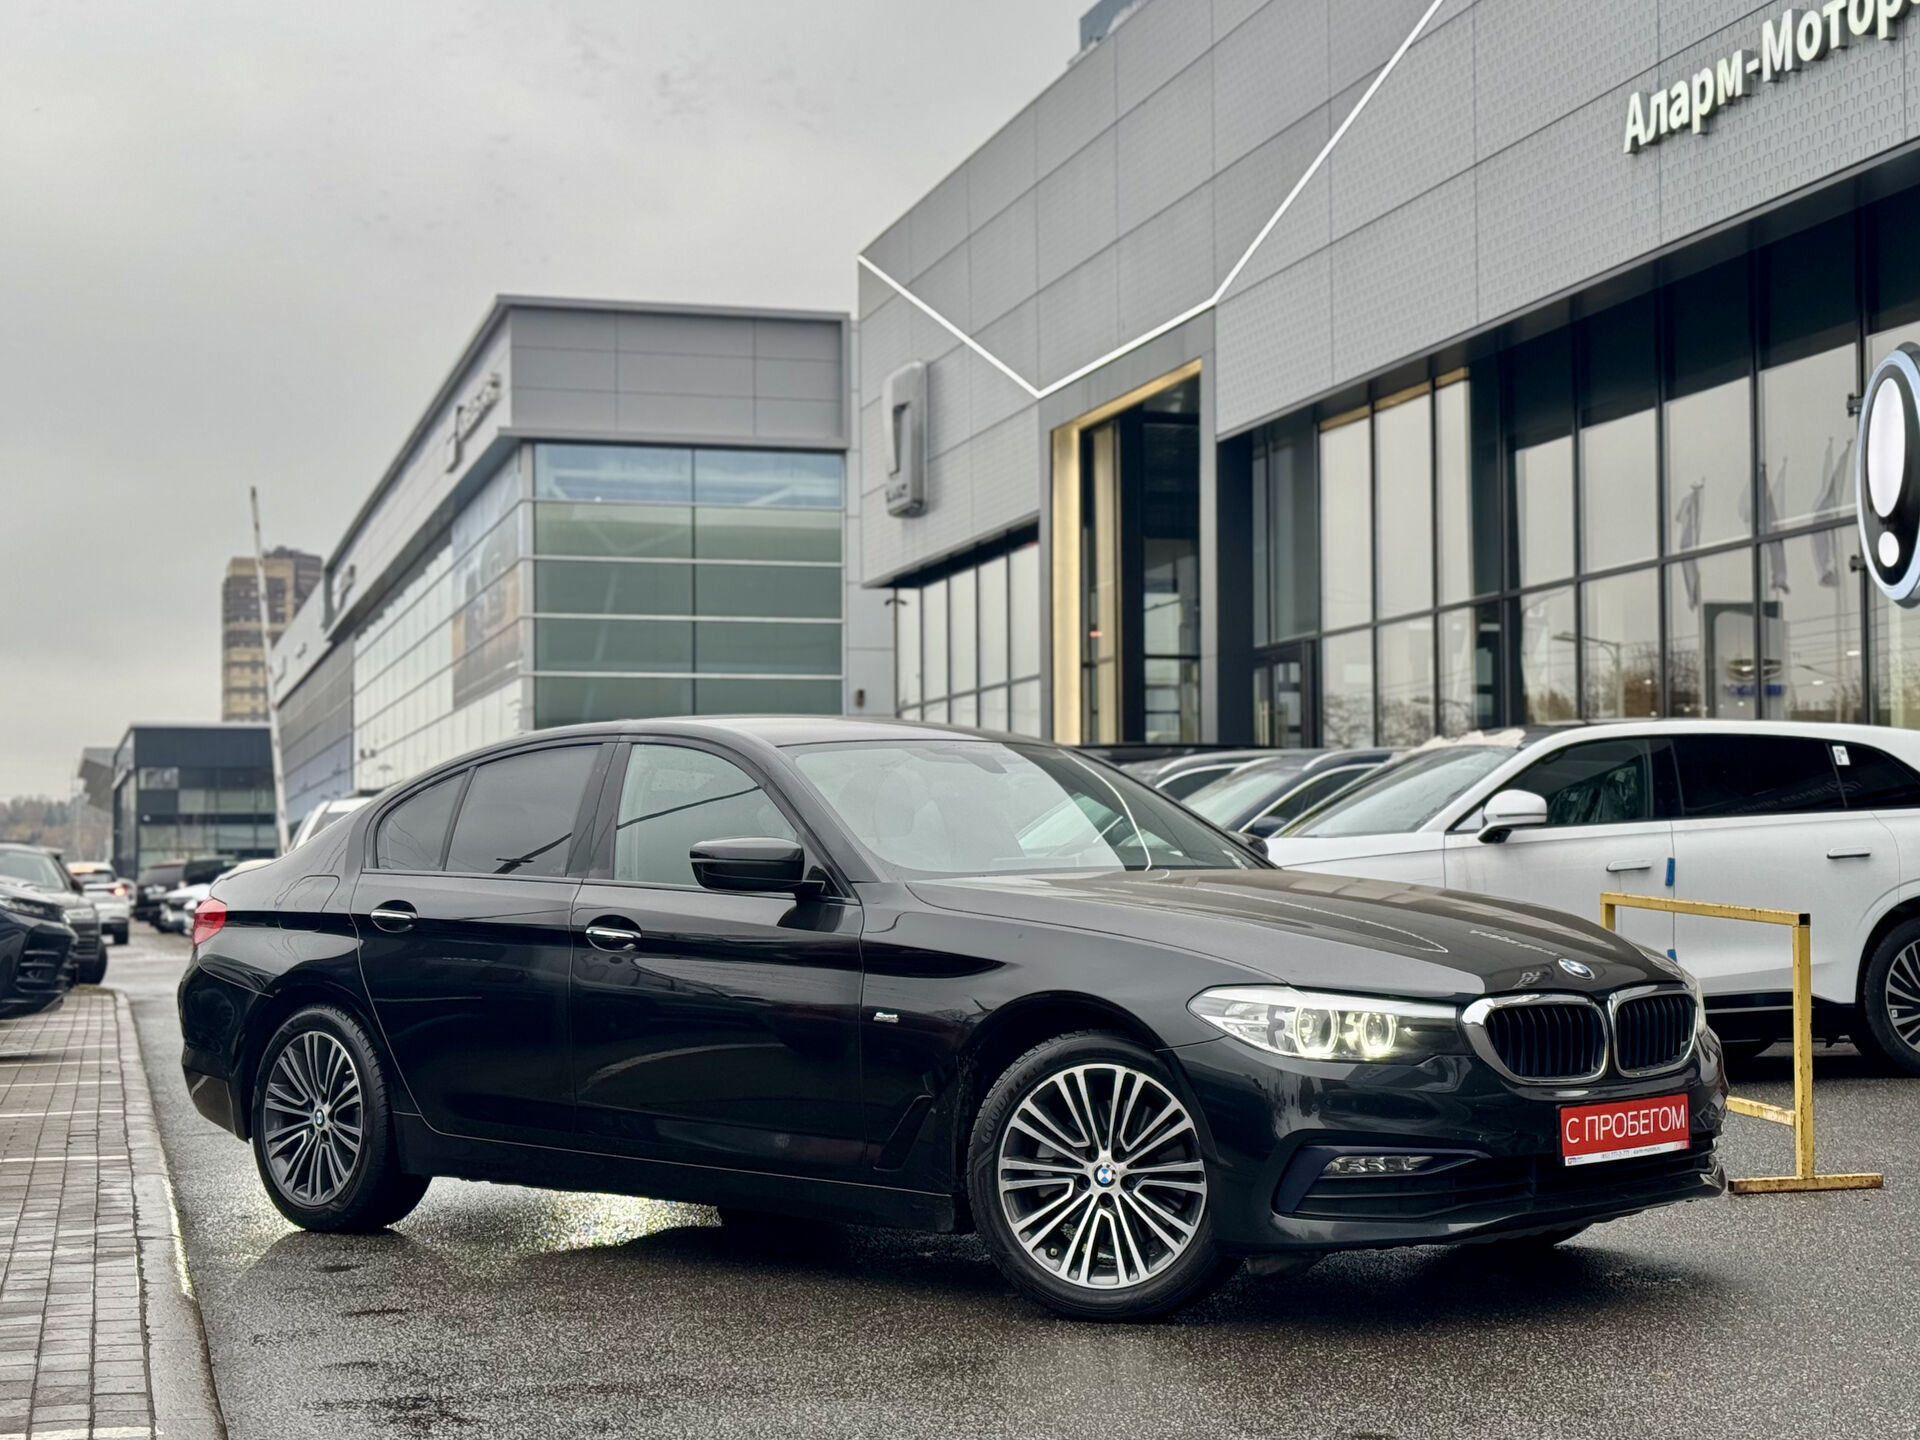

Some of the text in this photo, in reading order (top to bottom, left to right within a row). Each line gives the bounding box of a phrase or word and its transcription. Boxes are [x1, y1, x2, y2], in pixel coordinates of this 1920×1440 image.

[1623, 0, 1920, 153] Аларм-Мотор
[1566, 1104, 1685, 1144] С ПРОБЕГОМ
